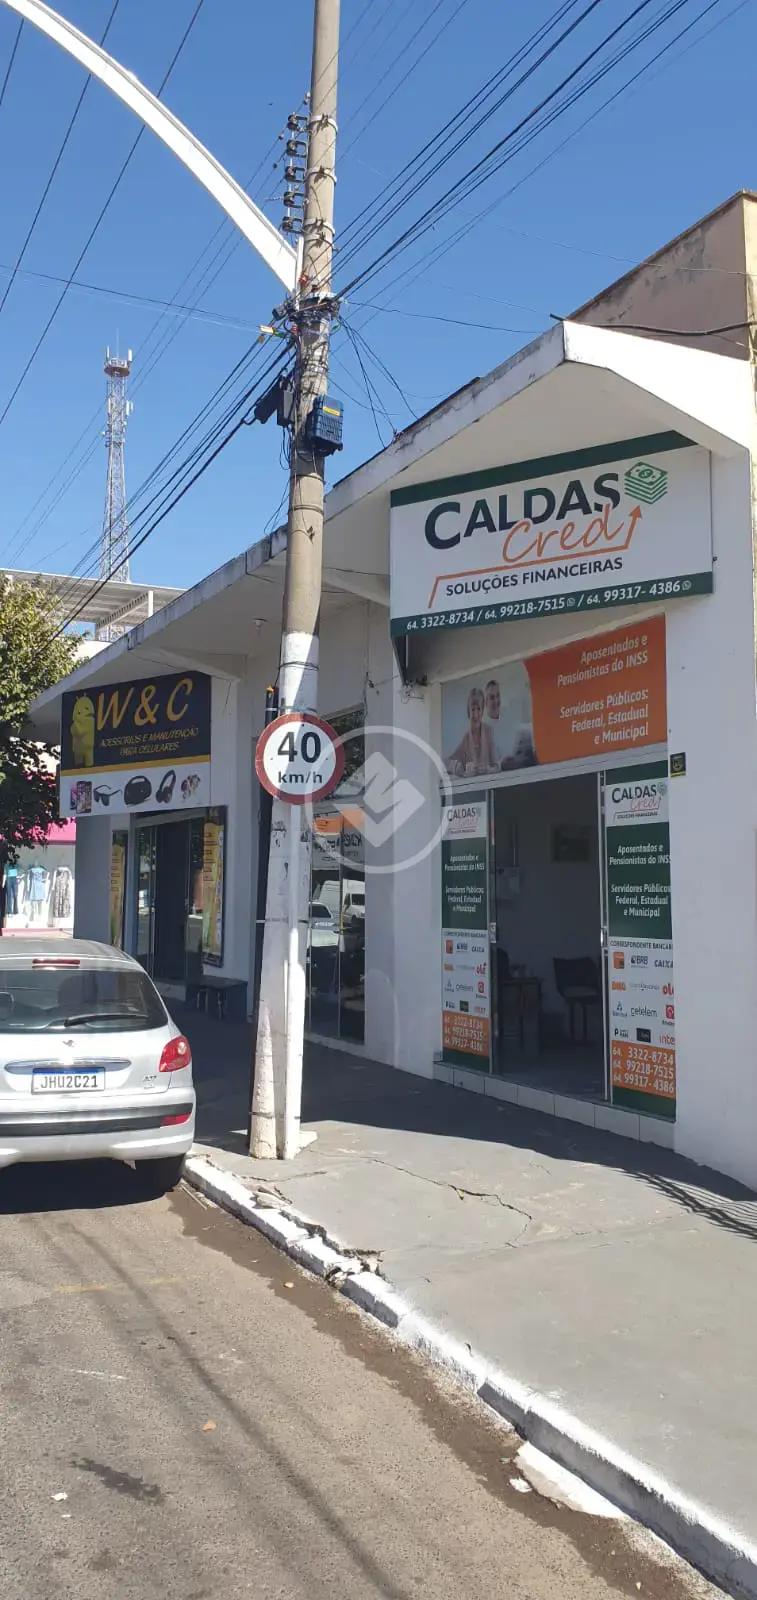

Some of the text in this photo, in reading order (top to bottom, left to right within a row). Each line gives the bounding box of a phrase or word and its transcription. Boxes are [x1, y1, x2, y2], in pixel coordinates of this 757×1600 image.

[424, 472, 621, 550] CALDAS
[502, 503, 625, 563] Cred
[446, 557, 623, 596] SOLUÇÕES FINANCEIRAS
[406, 621, 418, 630] 64.
[420, 610, 474, 628] 3322-8734
[476, 609, 482, 621] /
[484, 610, 498, 620] 64.
[500, 598, 564, 617] 99218-7515
[577, 594, 584, 608] /
[586, 594, 600, 604] 64.
[649, 580, 680, 596] 4386
[580, 635, 648, 664] Aposentados e
[557, 650, 648, 688] Pensionistas do INSS
[97, 678, 194, 731] W & C
[560, 688, 648, 718] Servidores Públicos:
[571, 704, 648, 734] Federal, Estadual
[594, 722, 648, 744] e Municipal
[278, 732, 322, 764] 40
[278, 772, 322, 784] km/h
[612, 784, 656, 804] CALDAS
[618, 843, 664, 856] Aposentados e
[609, 856, 646, 865] Pensionistas
[648, 856, 656, 864] do
[611, 884, 642, 892] Servidores
[616, 896, 668, 905] Federal, Estadual
[629, 908, 660, 918] Municipal
[628, 1046, 674, 1065] 3322-8734
[626, 1059, 674, 1079] 99218-7515
[40, 1075, 98, 1089] JHU2C21
[653, 1079, 674, 1093] 4386
